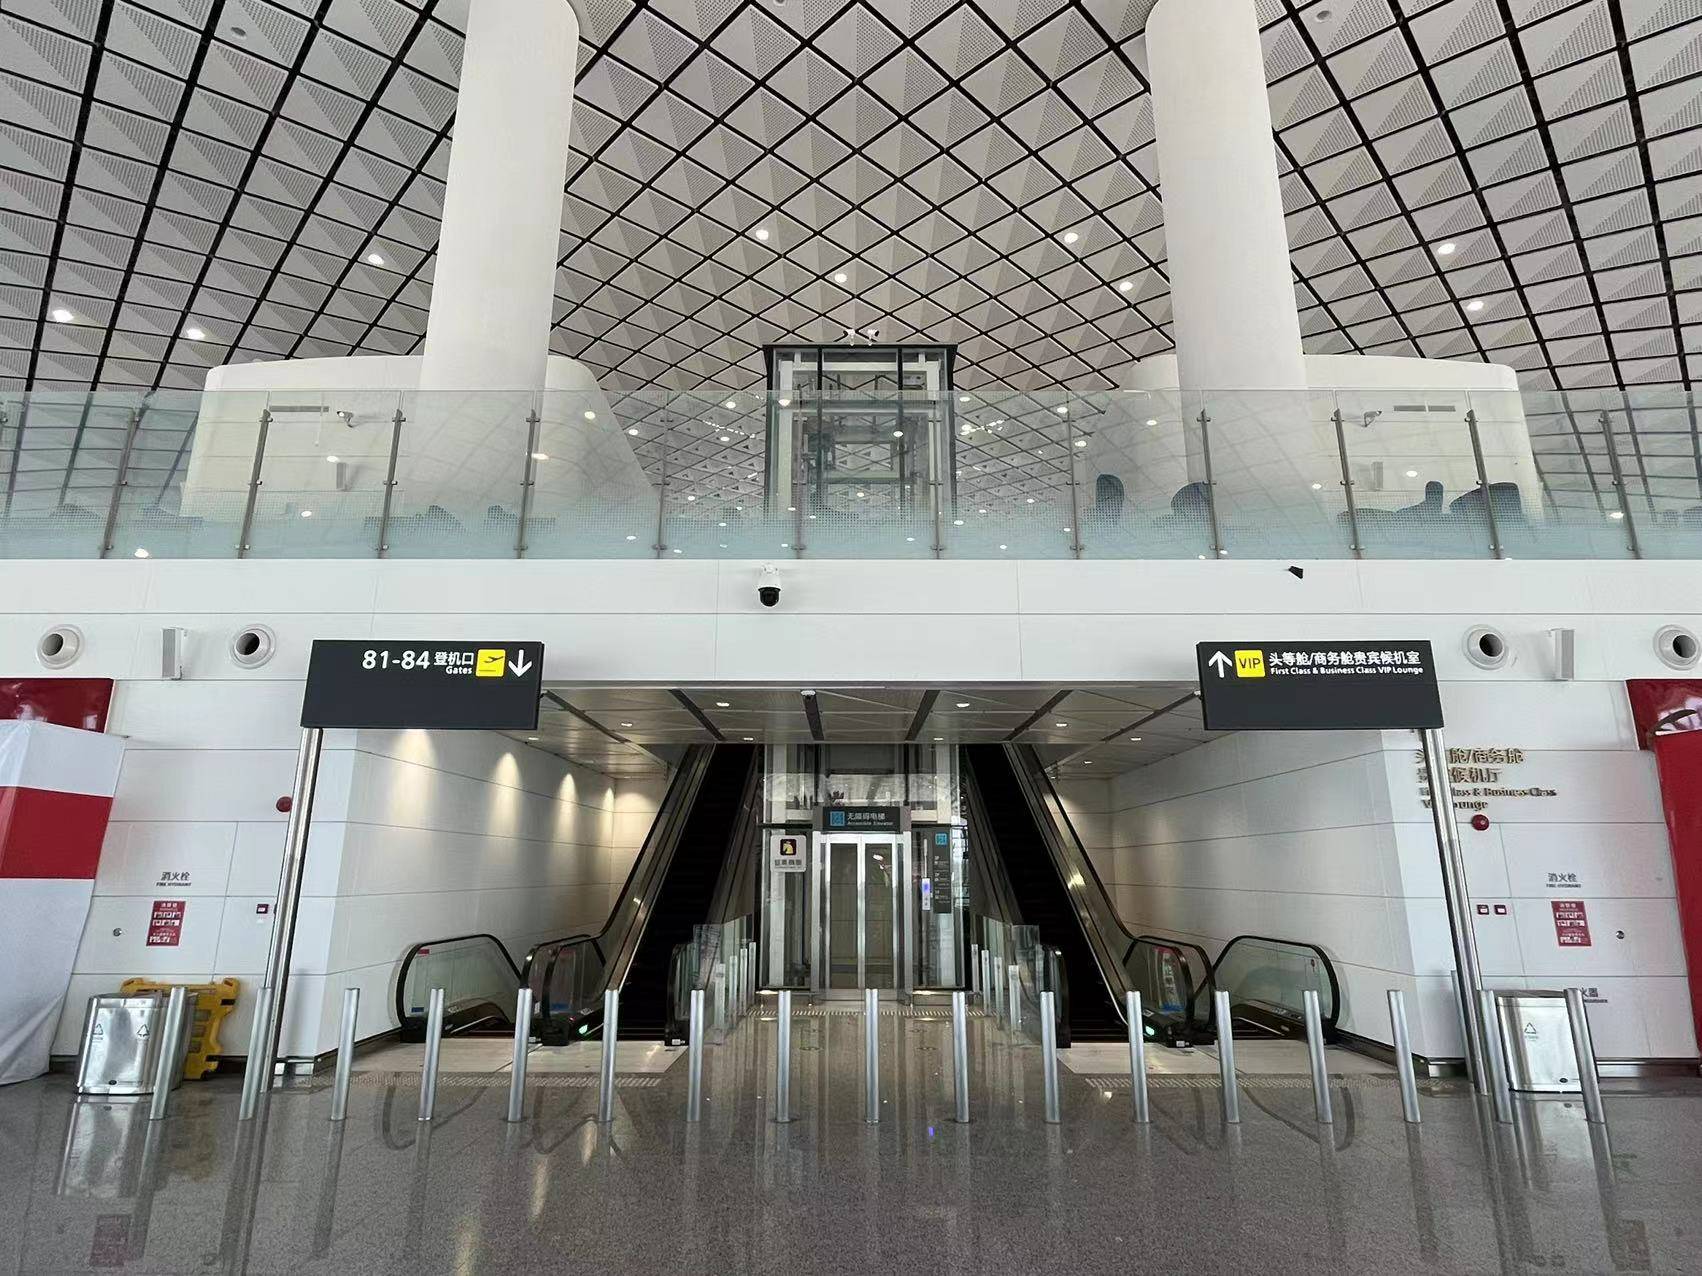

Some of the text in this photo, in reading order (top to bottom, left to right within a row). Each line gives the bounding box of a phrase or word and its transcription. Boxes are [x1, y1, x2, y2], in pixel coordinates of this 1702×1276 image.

[362, 650, 474, 669] 81-84 登机口
[1239, 657, 1261, 669] VIP
[1269, 651, 1421, 666] 头等舱/商务舱贵宾候机室
[445, 665, 473, 675] Gates
[1270, 667, 1289, 675] First
[1290, 667, 1311, 675] Class
[1320, 667, 1355, 675] Business
[1356, 666, 1377, 674] Class
[1378, 666, 1392, 674] VIP
[1393, 666, 1423, 675] Lounge
[1453, 800, 1489, 812] ounge
[160, 871, 190, 881] 消火栓
[1548, 872, 1577, 883] 消火栓
